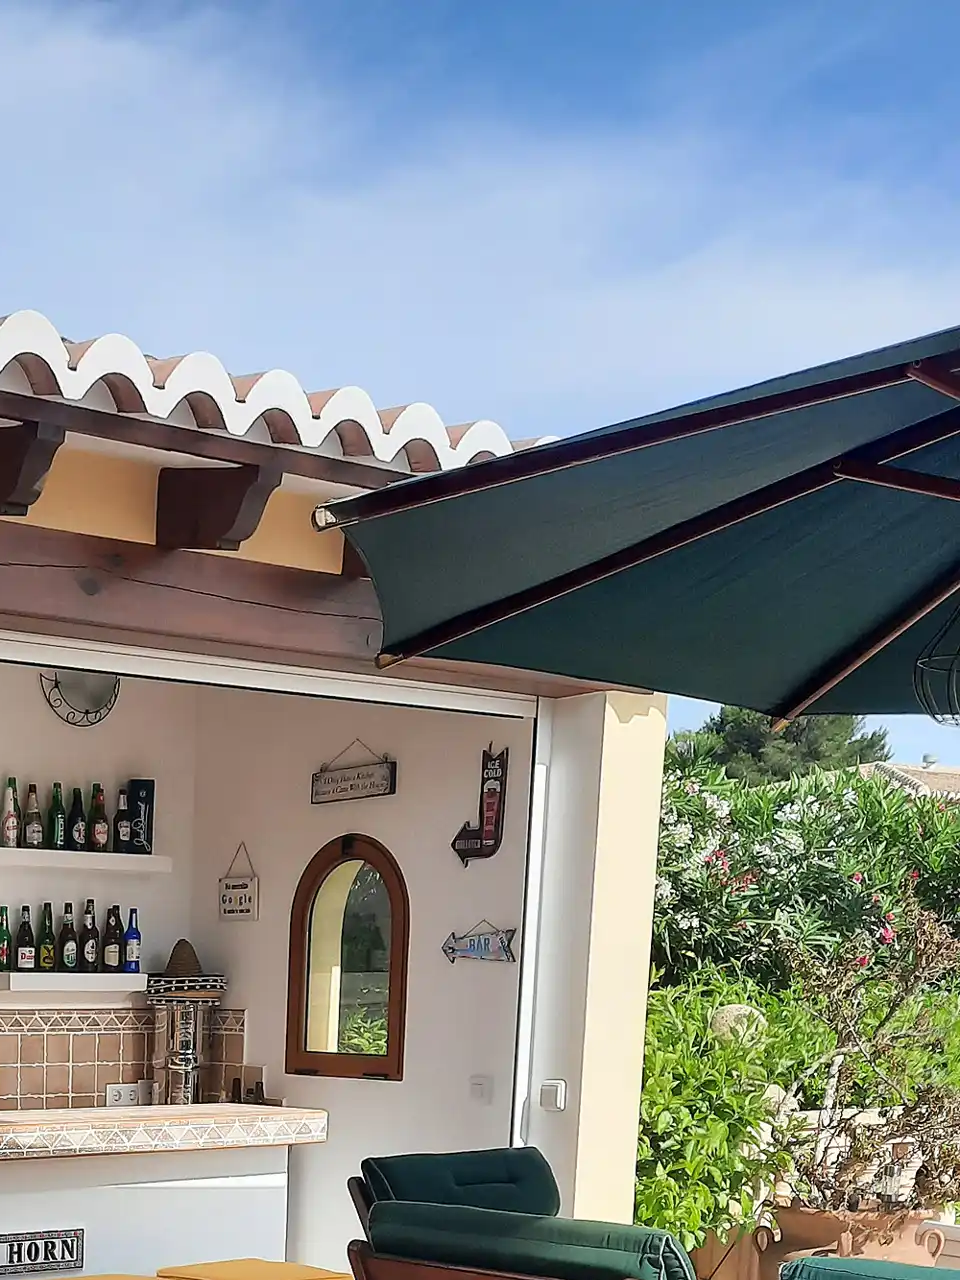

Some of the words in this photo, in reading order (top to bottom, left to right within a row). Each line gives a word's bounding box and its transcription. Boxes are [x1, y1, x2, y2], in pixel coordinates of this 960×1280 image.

[488, 760, 500, 769] ICE
[484, 768, 502, 778] COLD
[469, 937, 491, 953] BAR
[7, 1239, 77, 1264] HORN
